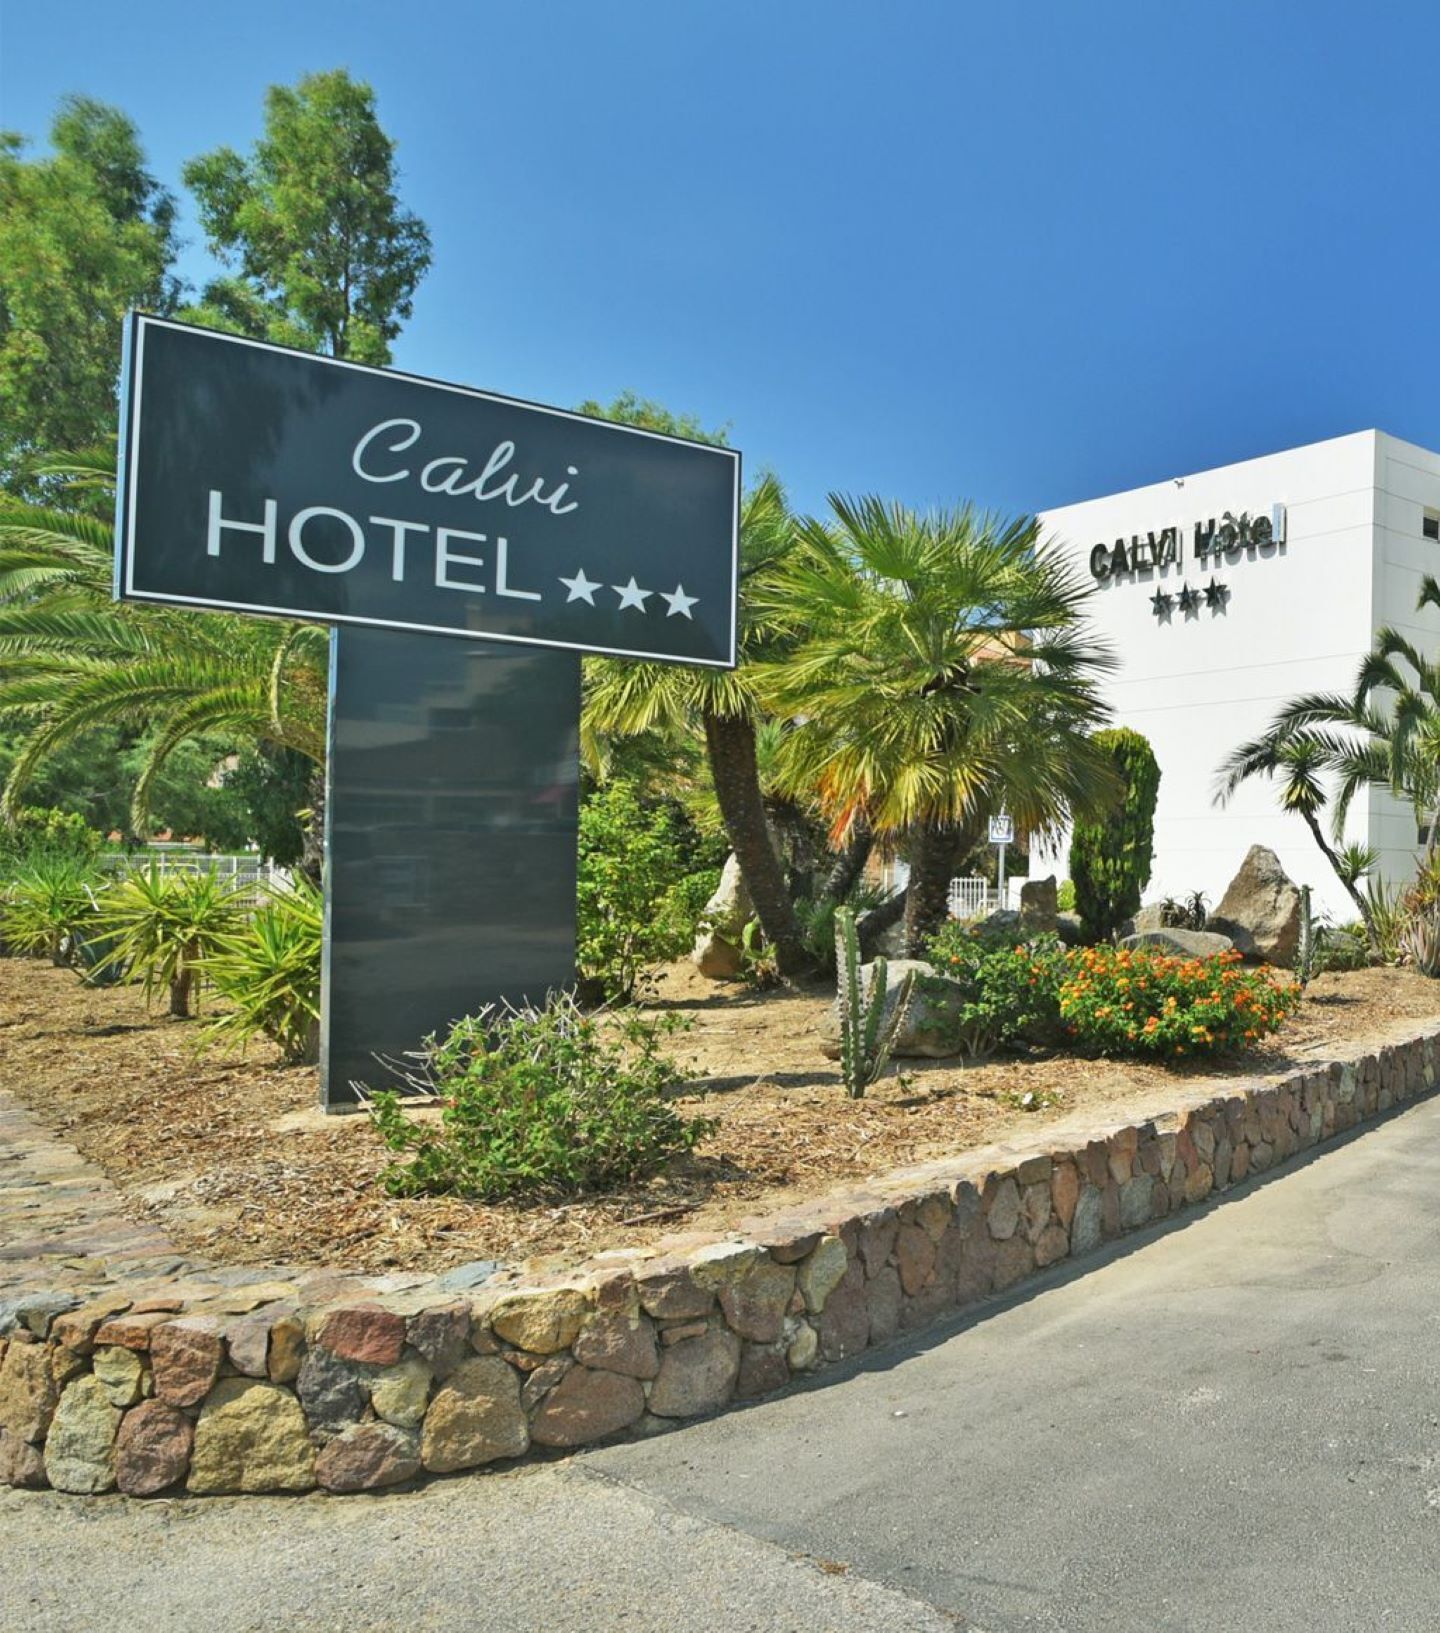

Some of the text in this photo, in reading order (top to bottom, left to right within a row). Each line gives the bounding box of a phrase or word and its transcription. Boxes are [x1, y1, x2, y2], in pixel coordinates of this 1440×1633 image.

[351, 418, 579, 515] Calvi
[207, 490, 542, 601] HOTEL
[1090, 525, 1182, 580] CALVI
